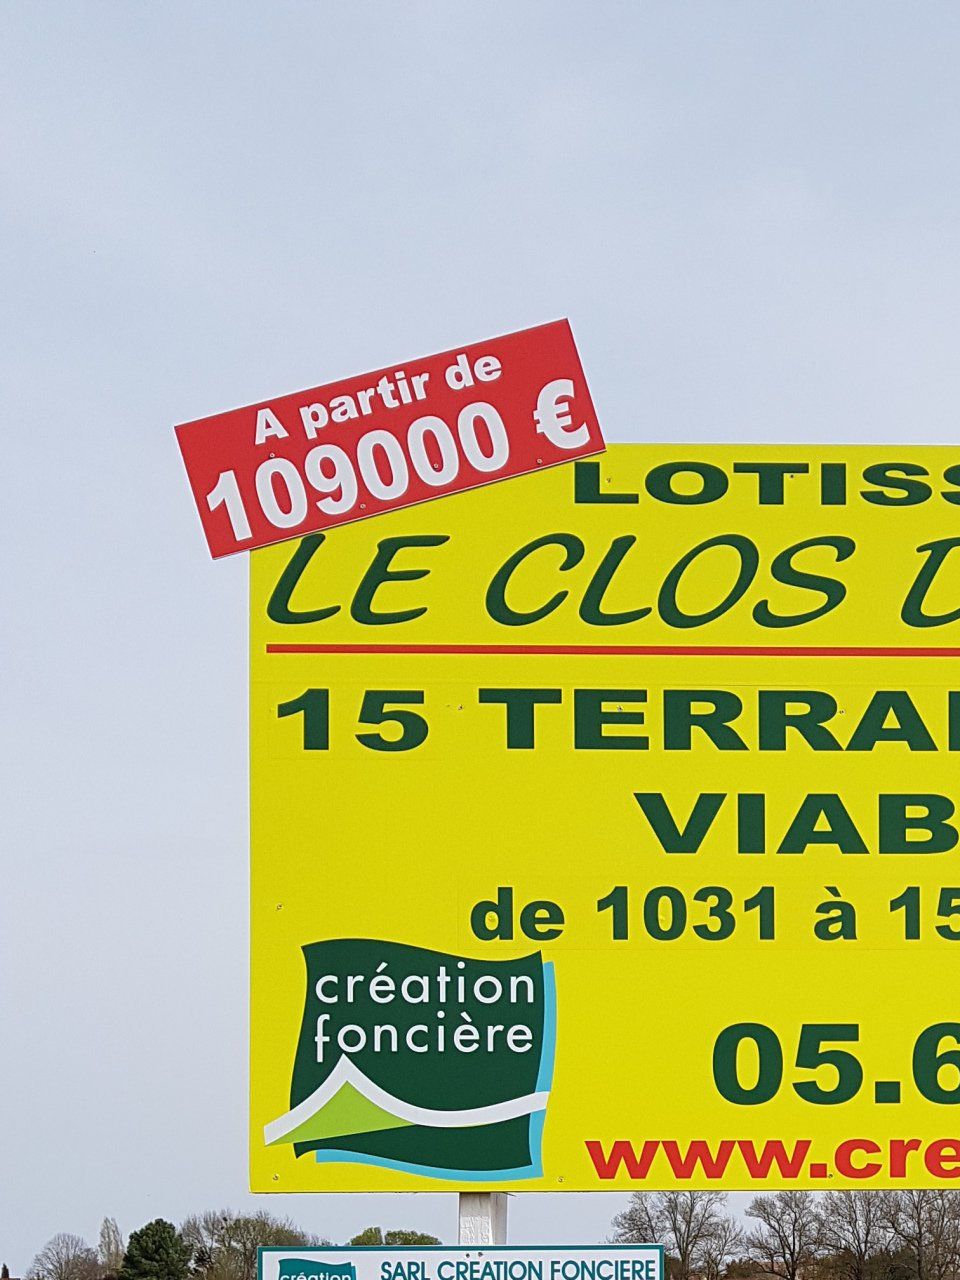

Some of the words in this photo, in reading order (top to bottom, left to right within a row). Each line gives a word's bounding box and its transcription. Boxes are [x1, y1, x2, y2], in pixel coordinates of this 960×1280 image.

[256, 409, 288, 444] A
[299, 369, 431, 435] partir
[445, 352, 502, 392] de
[205, 400, 510, 542] 109000
[534, 378, 592, 450] €
[266, 532, 451, 627] LE
[486, 533, 855, 628] CLOS
[278, 689, 428, 751] 15
[471, 887, 564, 940] de
[598, 886, 774, 940] 1031
[814, 887, 857, 940] à
[316, 963, 533, 1003] création
[315, 1010, 532, 1063] foncière
[550, 1259, 656, 1280] FONCIERE
